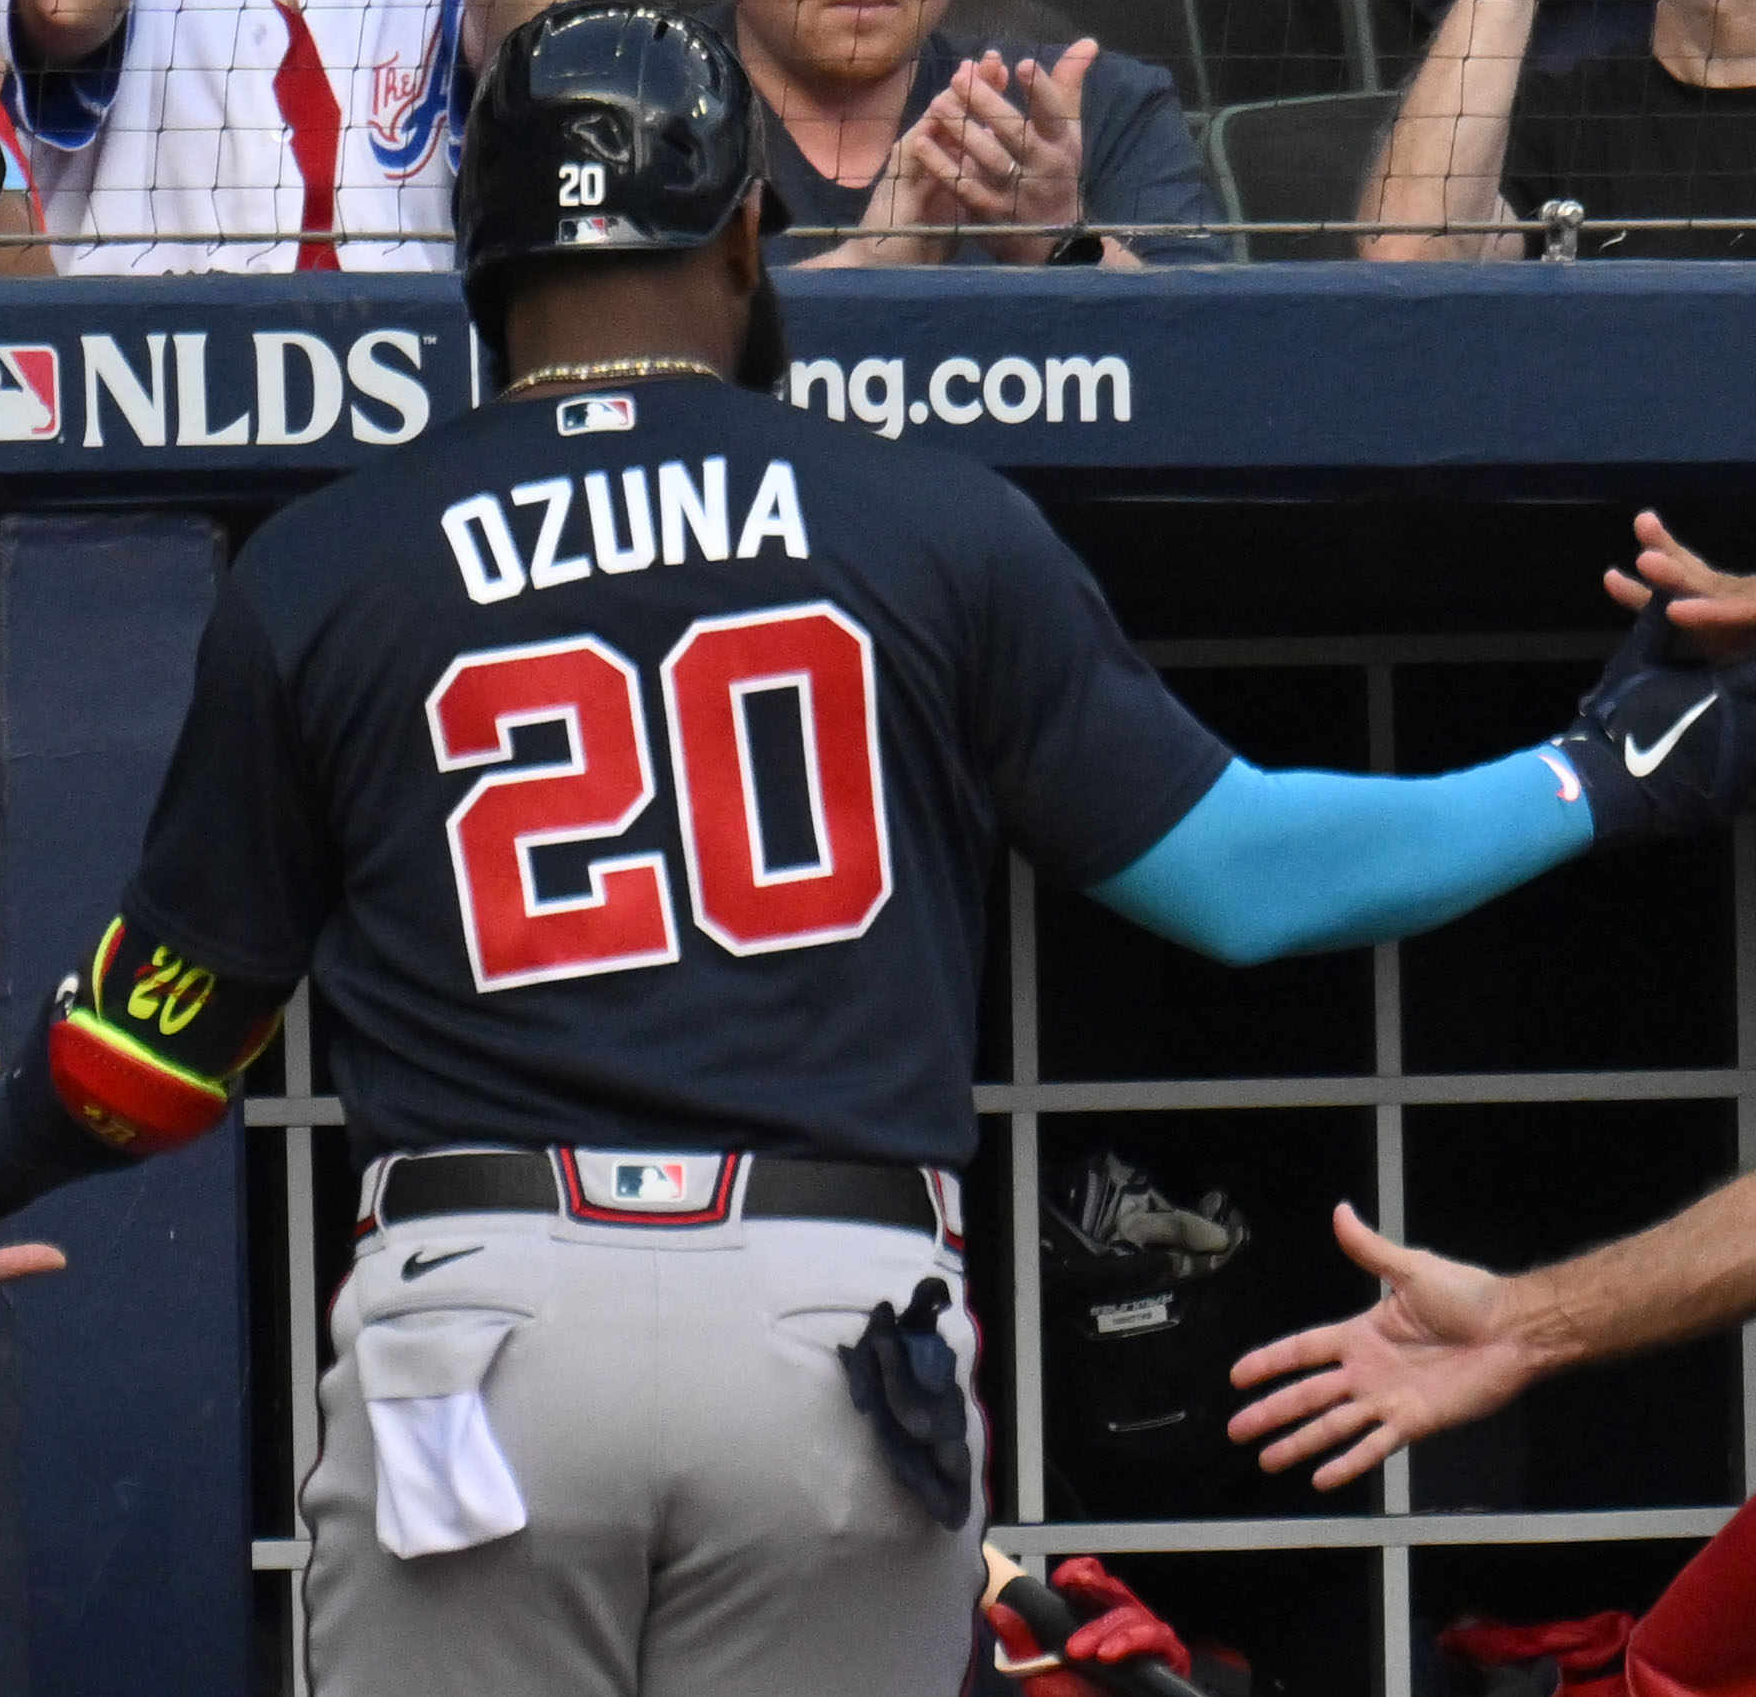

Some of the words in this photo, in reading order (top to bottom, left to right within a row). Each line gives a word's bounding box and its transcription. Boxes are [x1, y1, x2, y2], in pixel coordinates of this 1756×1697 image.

[558, 163, 606, 207] 20
[81, 329, 431, 446] NLDS
[443, 456, 808, 604] OZUNA
[426, 600, 893, 994] 20
[128, 945, 217, 1036] 20
